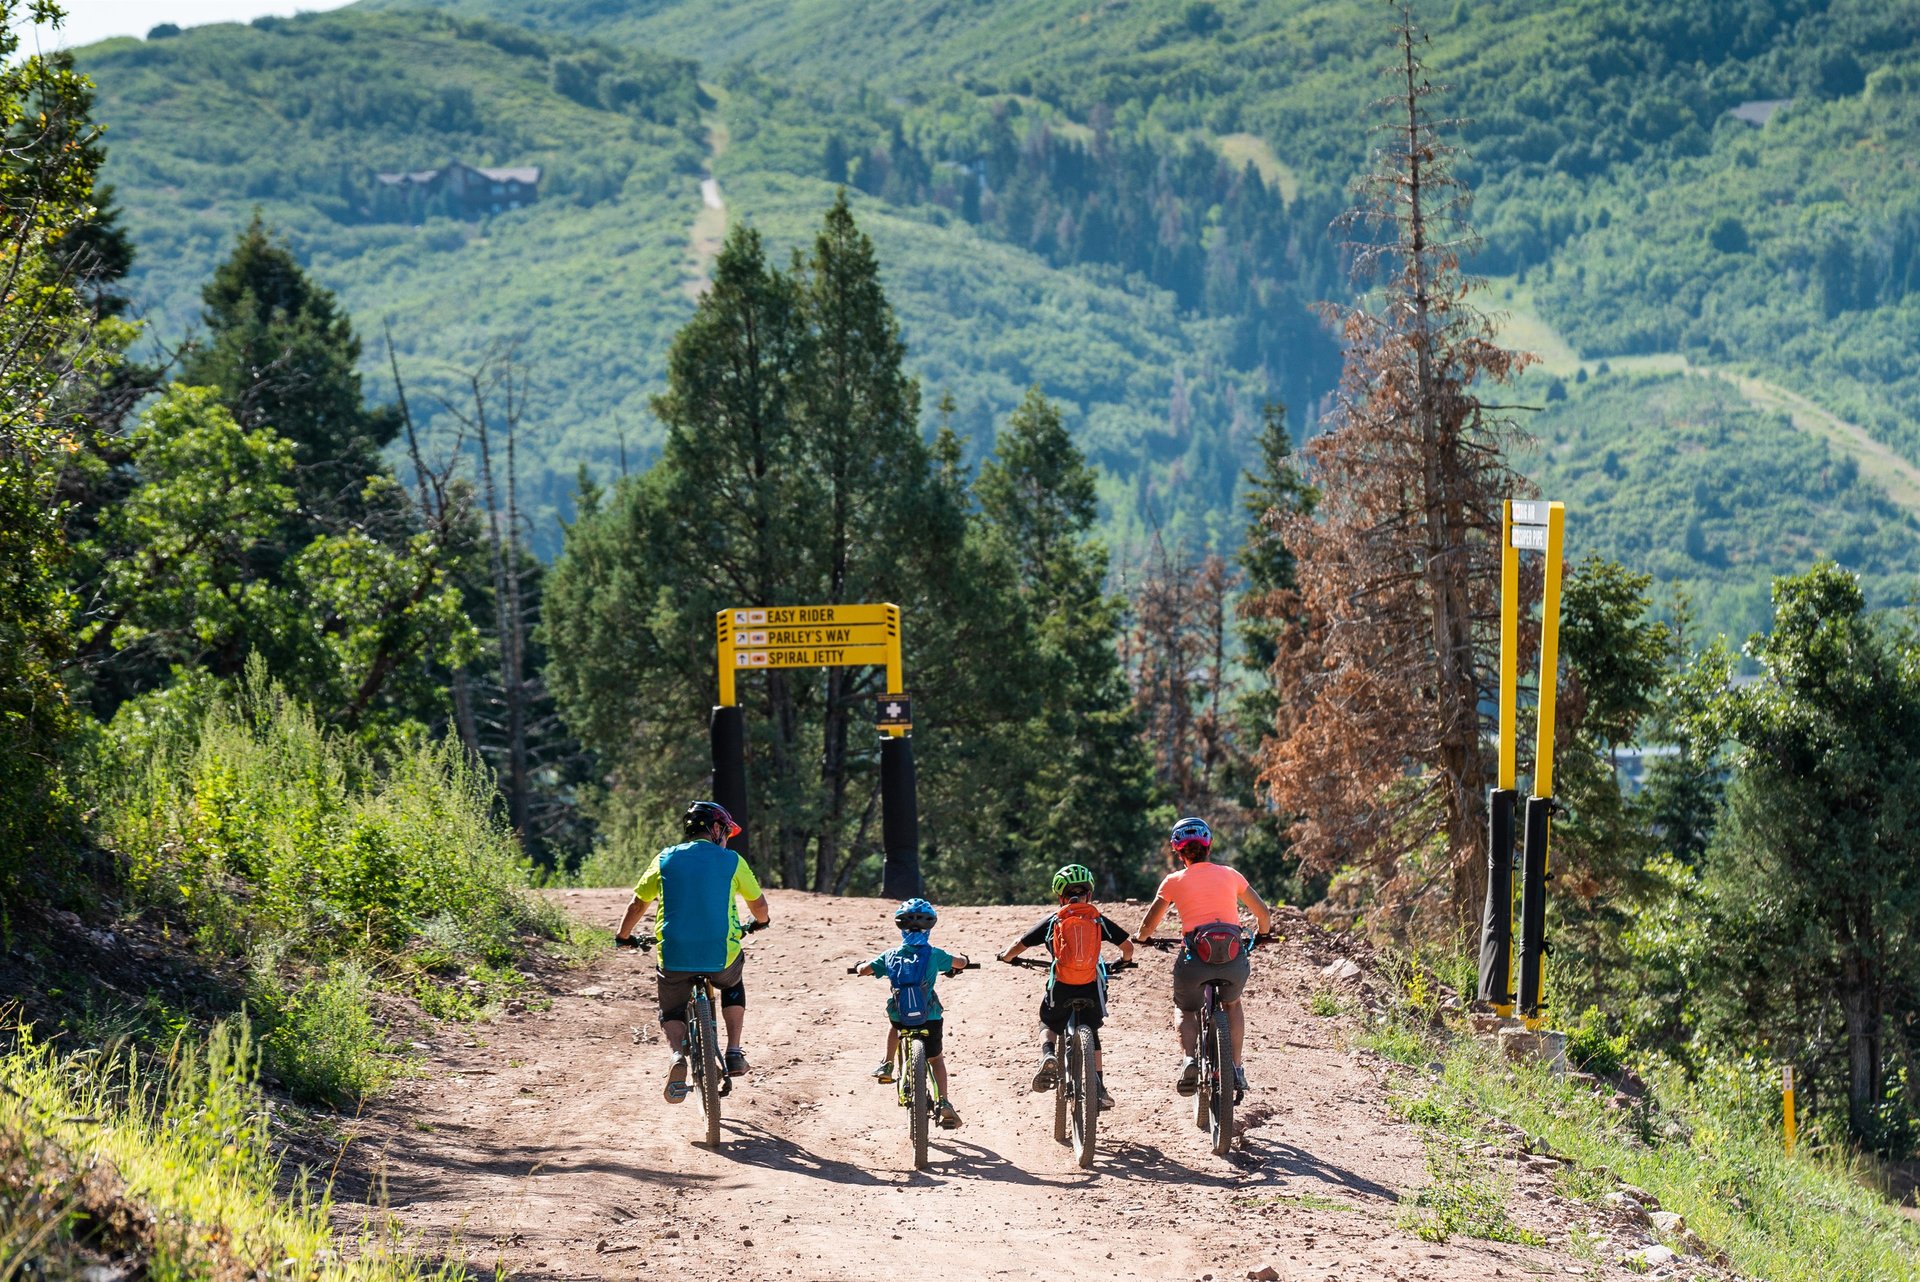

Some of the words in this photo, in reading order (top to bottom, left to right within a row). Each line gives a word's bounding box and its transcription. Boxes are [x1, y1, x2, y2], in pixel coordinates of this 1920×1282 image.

[767, 610, 795, 623] EASY
[799, 608, 834, 621] RIDER
[768, 630, 823, 644] PARLEY'S
[826, 628, 850, 642] WAY
[768, 651, 810, 665] SPIRAL
[813, 649, 844, 663] JETTY
